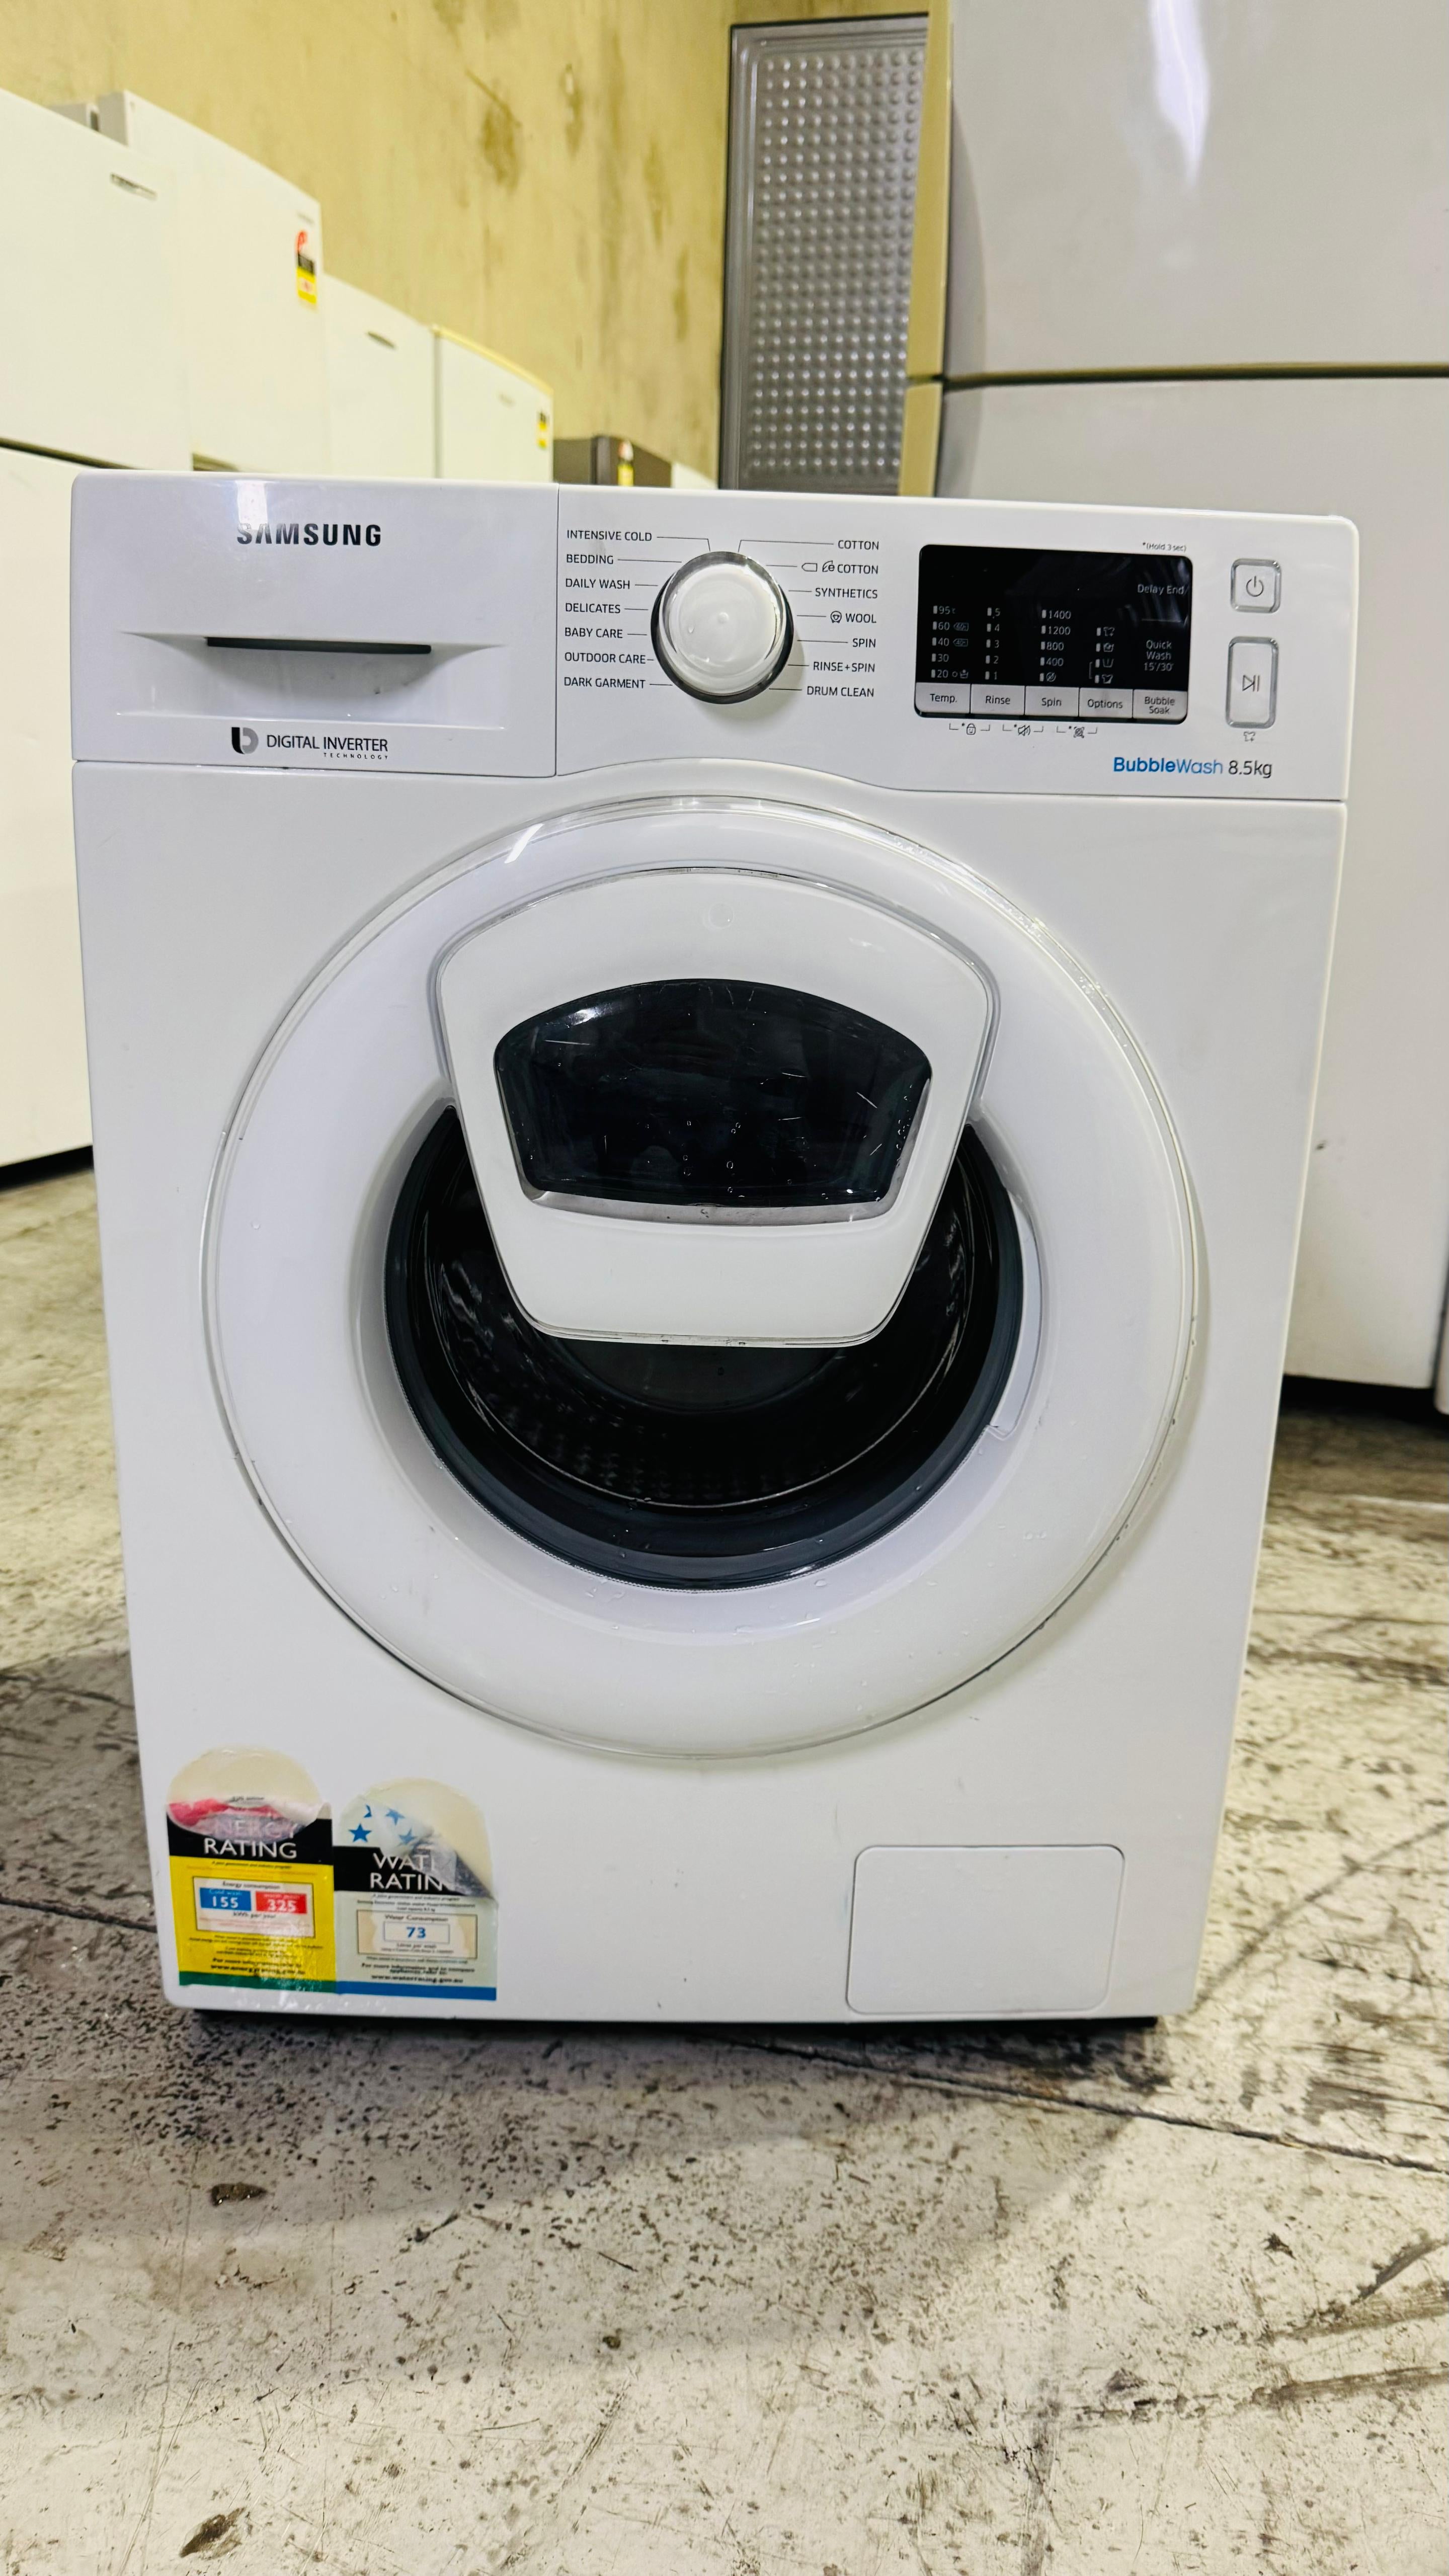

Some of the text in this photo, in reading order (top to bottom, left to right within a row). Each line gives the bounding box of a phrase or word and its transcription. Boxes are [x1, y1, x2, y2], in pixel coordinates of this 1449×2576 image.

[236, 523, 381, 546] SAMSUNG
[567, 530, 652, 541] INTENSIVE COLD
[838, 540, 879, 550] COTTON
[566, 554, 614, 565] BEDDING
[837, 564, 878, 575] COTTON
[566, 579, 630, 590] DAILY WASH
[815, 587, 878, 599] SYNTHETICS
[1137, 584, 1184, 596] Delay End
[565, 603, 621, 614] DELICATES
[995, 608, 1001, 616] 5
[845, 613, 877, 623] WOOL
[1048, 610, 1072, 619] 1400
[938, 621, 950, 630] 60
[994, 623, 1000, 632] 4
[1048, 626, 1071, 635] 1200
[565, 627, 623, 638] BABY CARE
[852, 638, 876, 648] SPIN
[938, 637, 950, 647] 40
[994, 639, 1000, 648] 3
[1046, 641, 1064, 651] 800
[1146, 640, 1172, 650] Quick
[565, 653, 646, 664] OUTDOOR CARE
[937, 654, 949, 662] 30
[993, 656, 999, 664] 2
[1146, 651, 1171, 660] Wash
[1046, 658, 1064, 667] 400
[937, 669, 949, 678] 20
[994, 671, 998, 680] 1
[564, 677, 646, 689] DARK GARMENT
[807, 686, 874, 697] DRUM CLEAN
[930, 694, 957, 703] Temp.
[985, 695, 1011, 704] Rinse
[1041, 697, 1062, 707] Spin
[1087, 698, 1123, 709] Options
[1144, 696, 1175, 705] Bubble
[1149, 705, 1170, 714] Soak
[267, 735, 388, 752] DIGITAL INVERTER
[1113, 757, 1272, 778] BubbleWash 8.5kg
[204, 1837, 297, 1859] RATING
[370, 1872, 443, 1891] RATIN
[212, 1895, 239, 1908] 155
[267, 1899, 297, 1912] 325
[406, 1926, 426, 1938] 73
